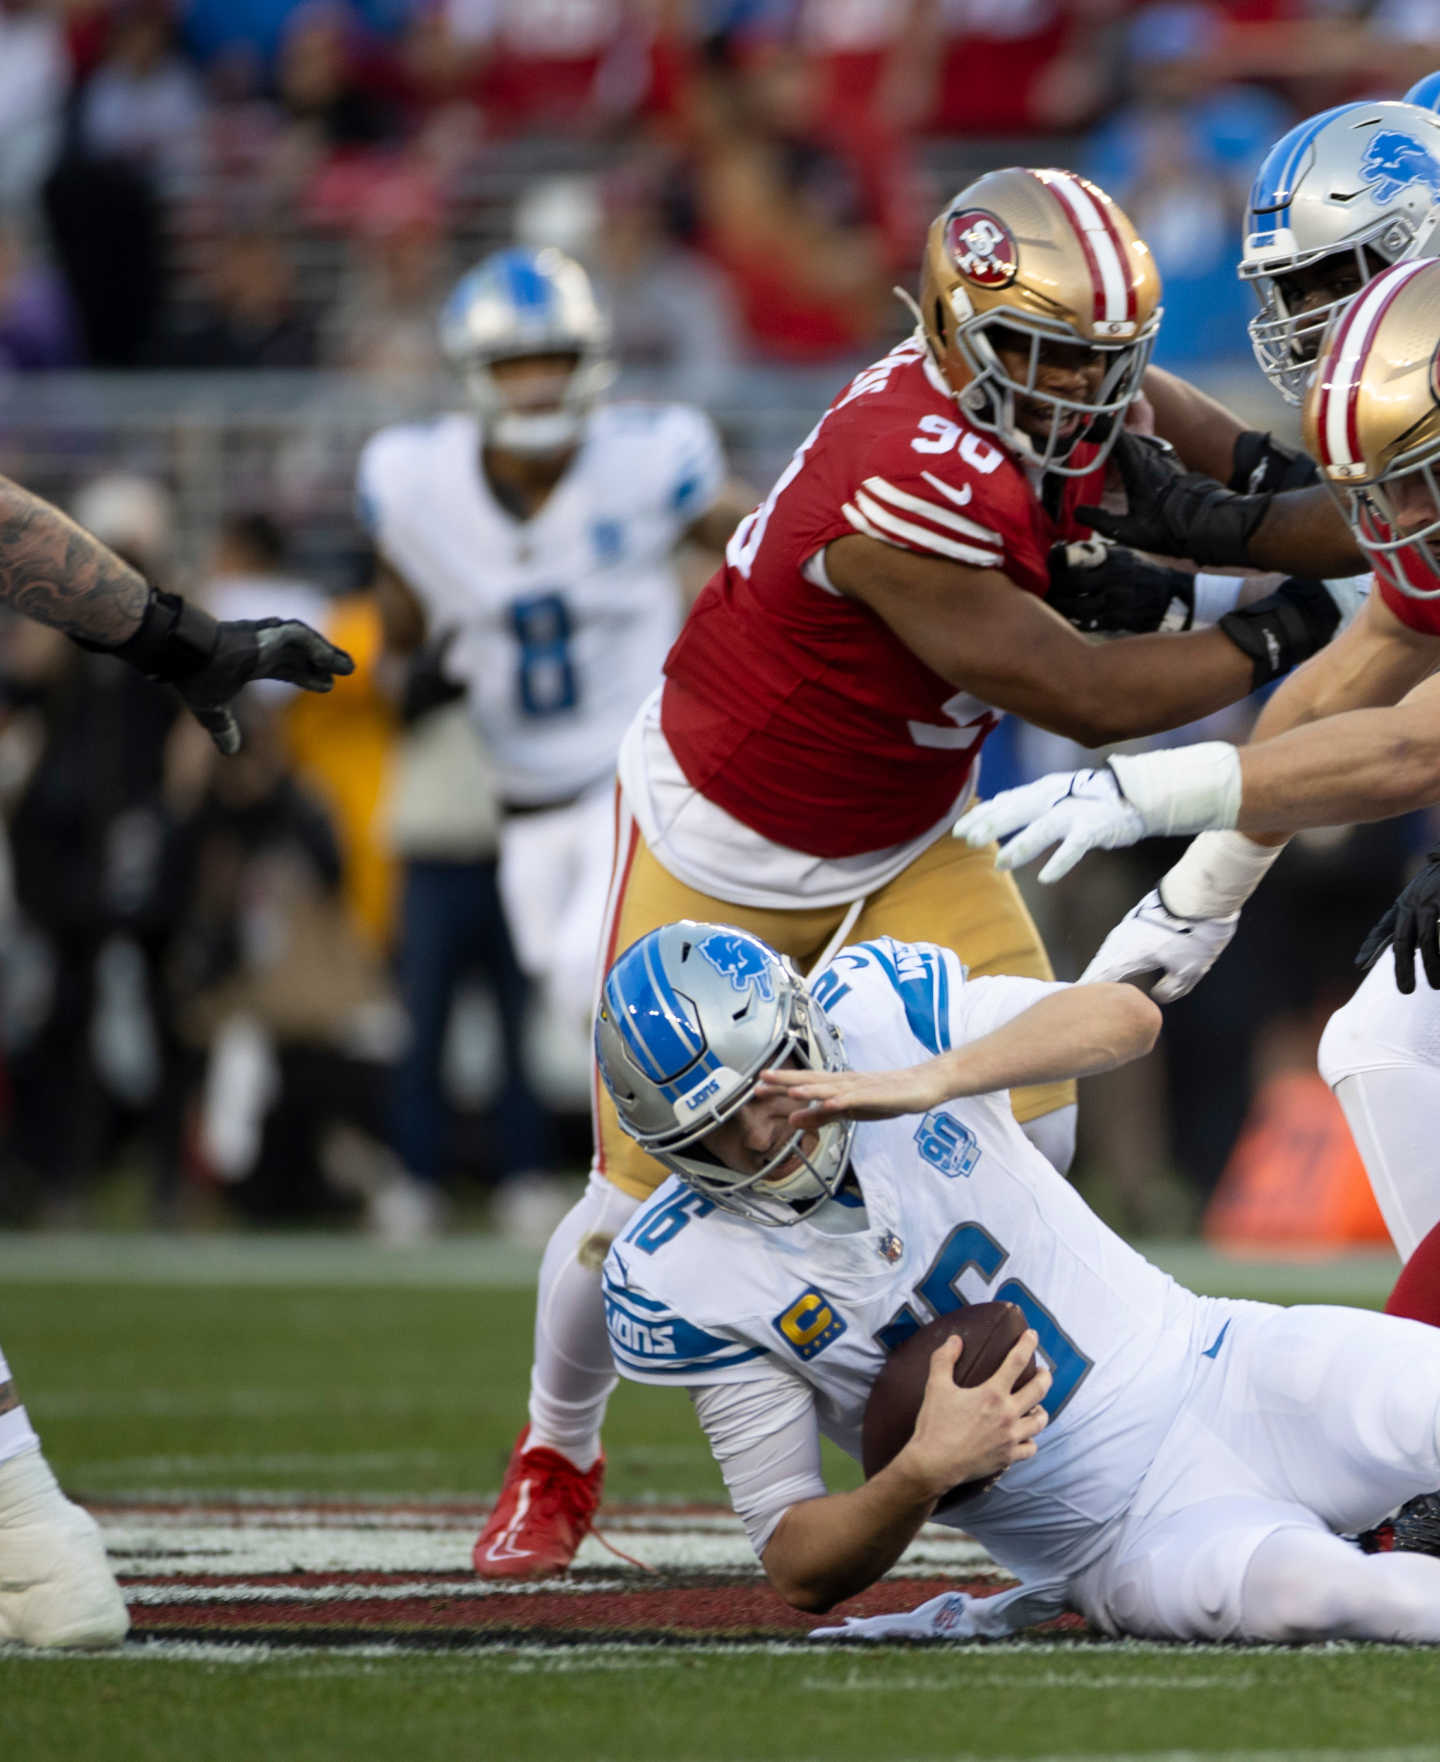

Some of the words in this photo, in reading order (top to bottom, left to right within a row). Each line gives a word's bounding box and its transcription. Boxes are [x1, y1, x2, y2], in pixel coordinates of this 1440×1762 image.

[911, 414, 1004, 474] 90
[511, 592, 578, 720] 8
[685, 1078, 720, 1111] LIONS
[624, 1182, 716, 1256] 16
[780, 1293, 832, 1346] C
[872, 1220, 1096, 1424] 6
